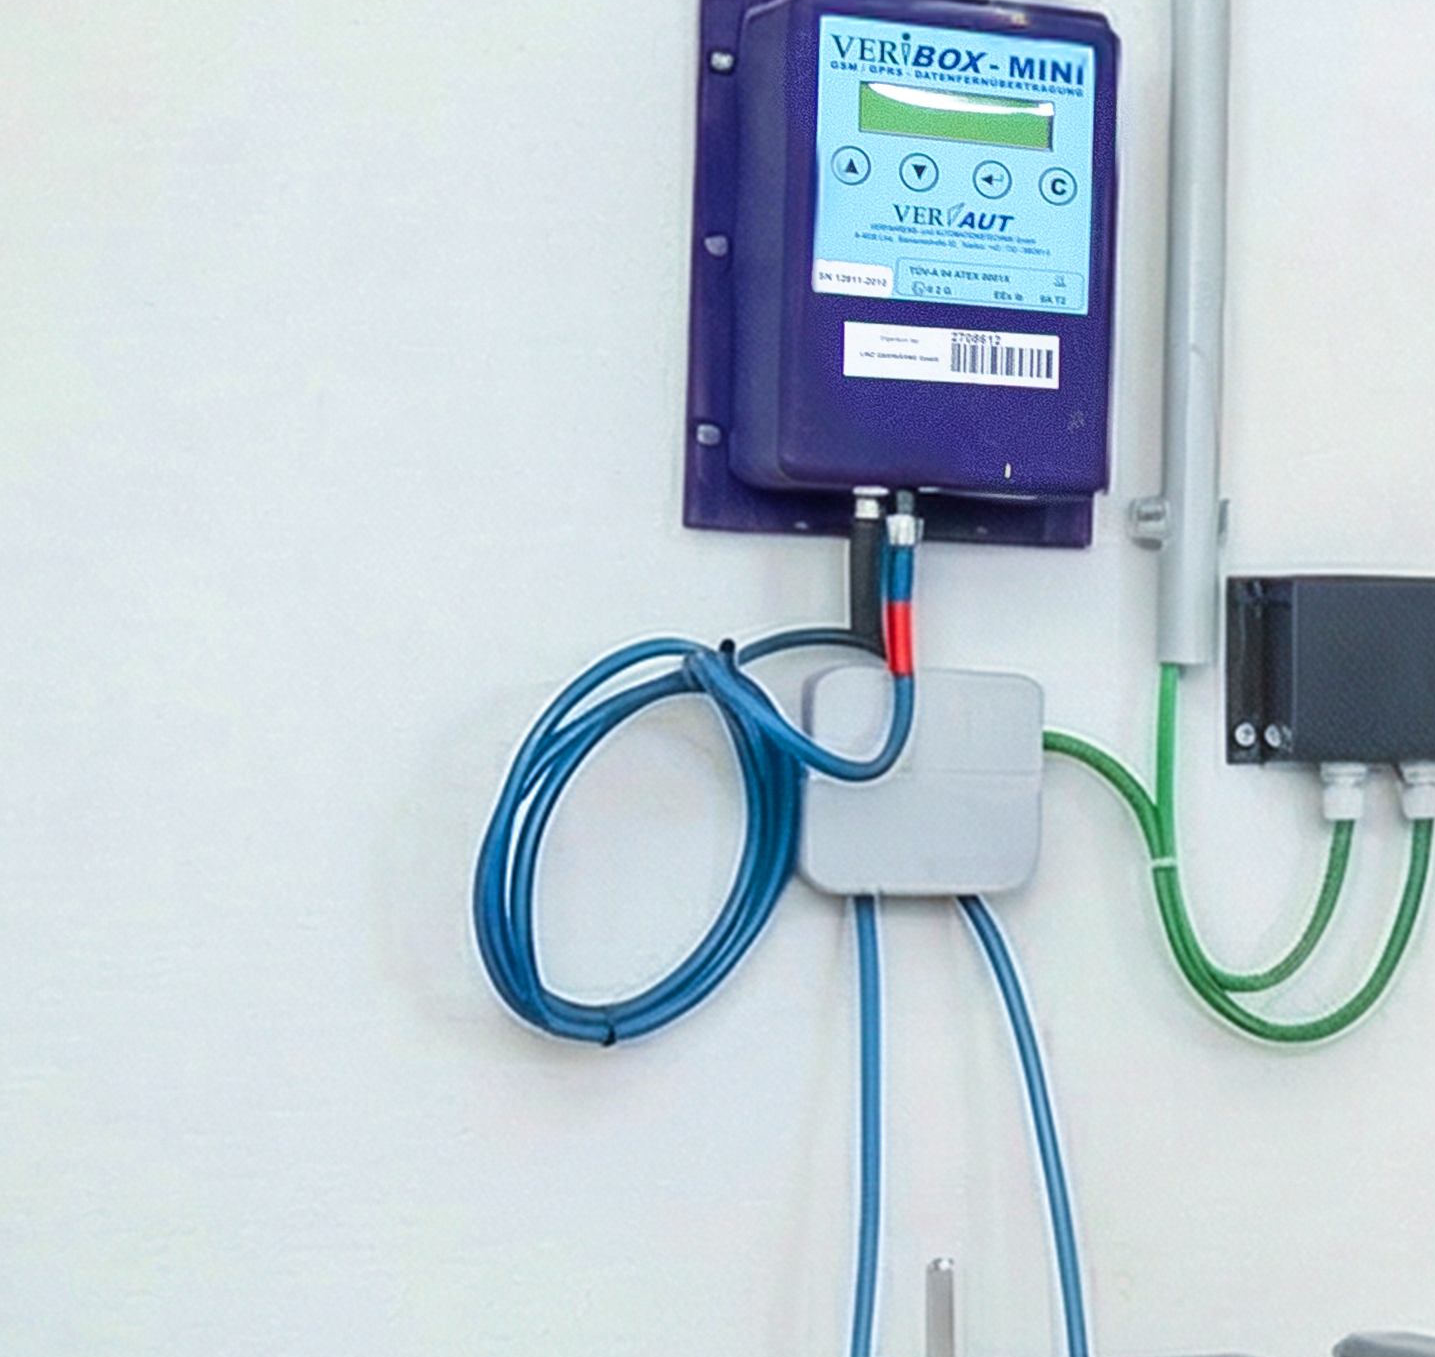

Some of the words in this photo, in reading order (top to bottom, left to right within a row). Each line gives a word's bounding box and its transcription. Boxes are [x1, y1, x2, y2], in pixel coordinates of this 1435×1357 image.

[830, 60, 858, 73] GSM
[869, 64, 904, 77] GPRS
[1009, 55, 1084, 86] MINI
[1050, 177, 1067, 196] C
